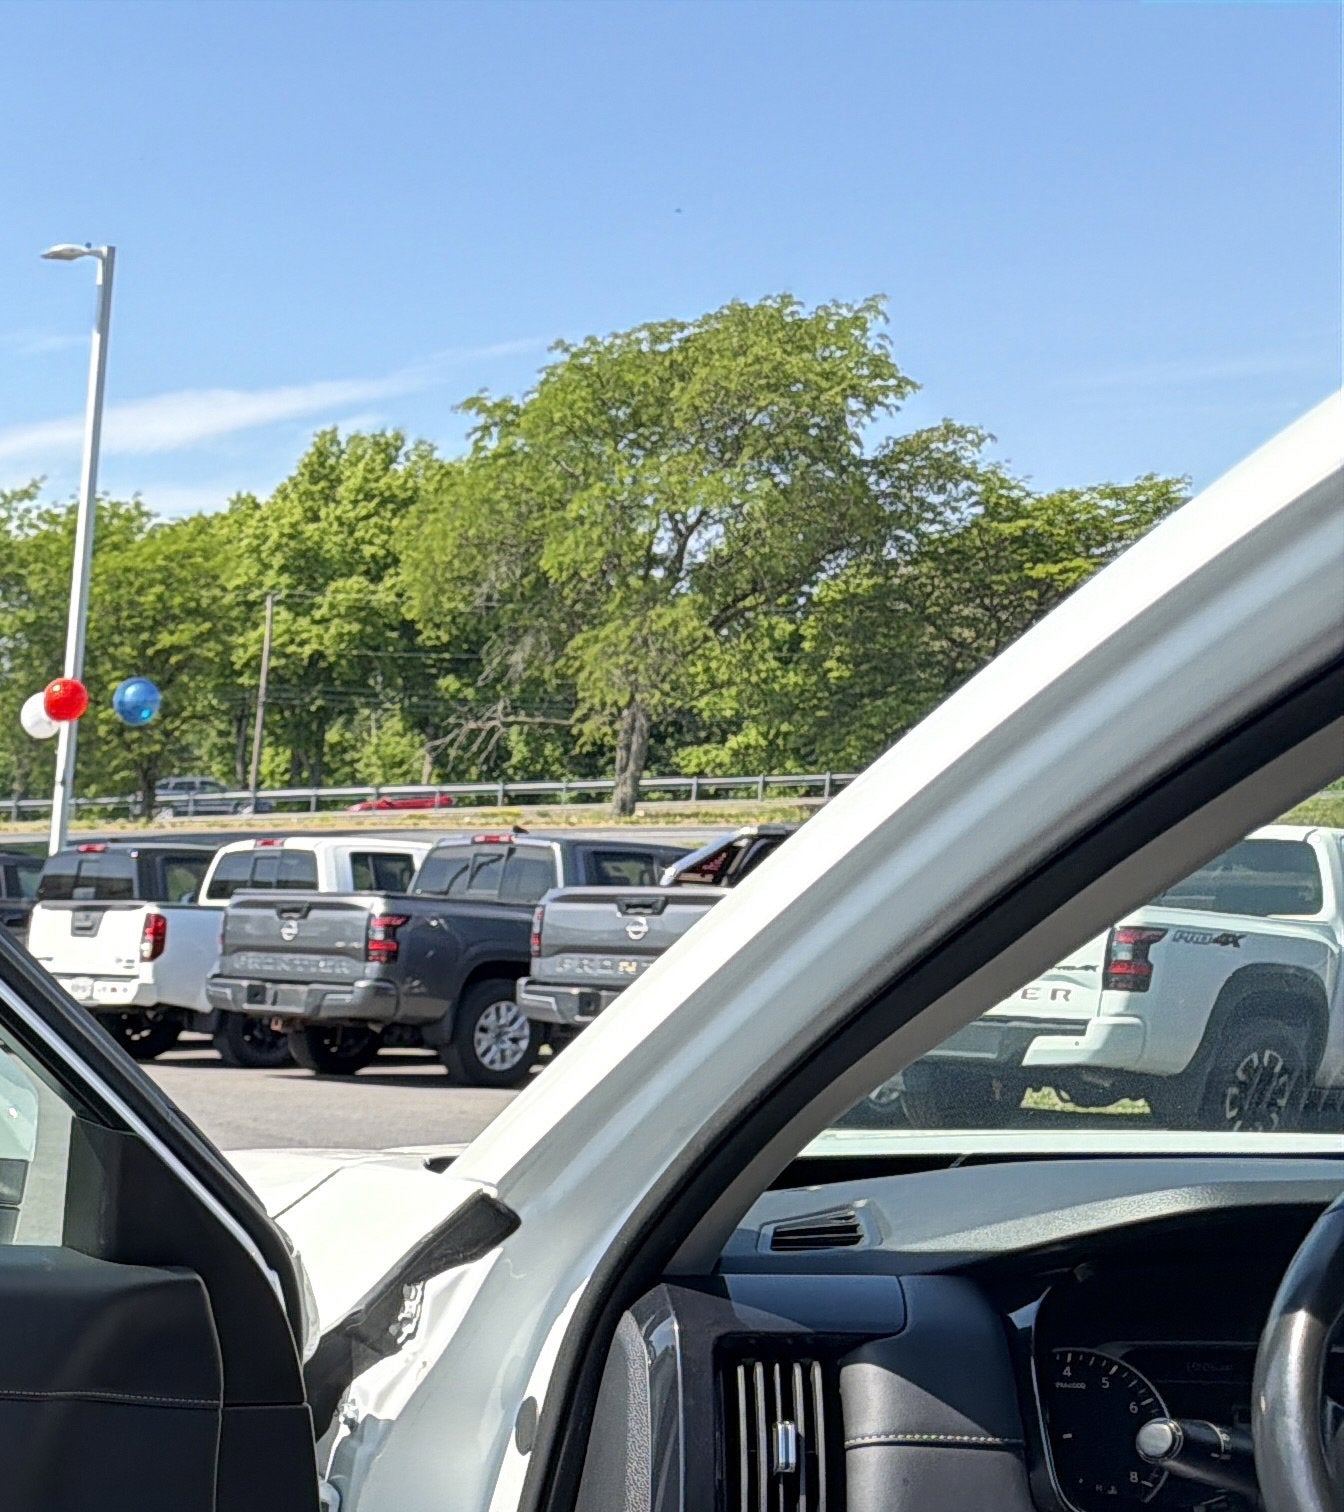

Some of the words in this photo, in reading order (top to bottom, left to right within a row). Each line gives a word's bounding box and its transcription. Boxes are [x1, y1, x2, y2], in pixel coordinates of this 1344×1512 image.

[1062, 1366, 1072, 1377] 4
[1101, 1377, 1110, 1389] 5
[1129, 1402, 1139, 1413] 6
[1129, 1471, 1139, 1483] 8
